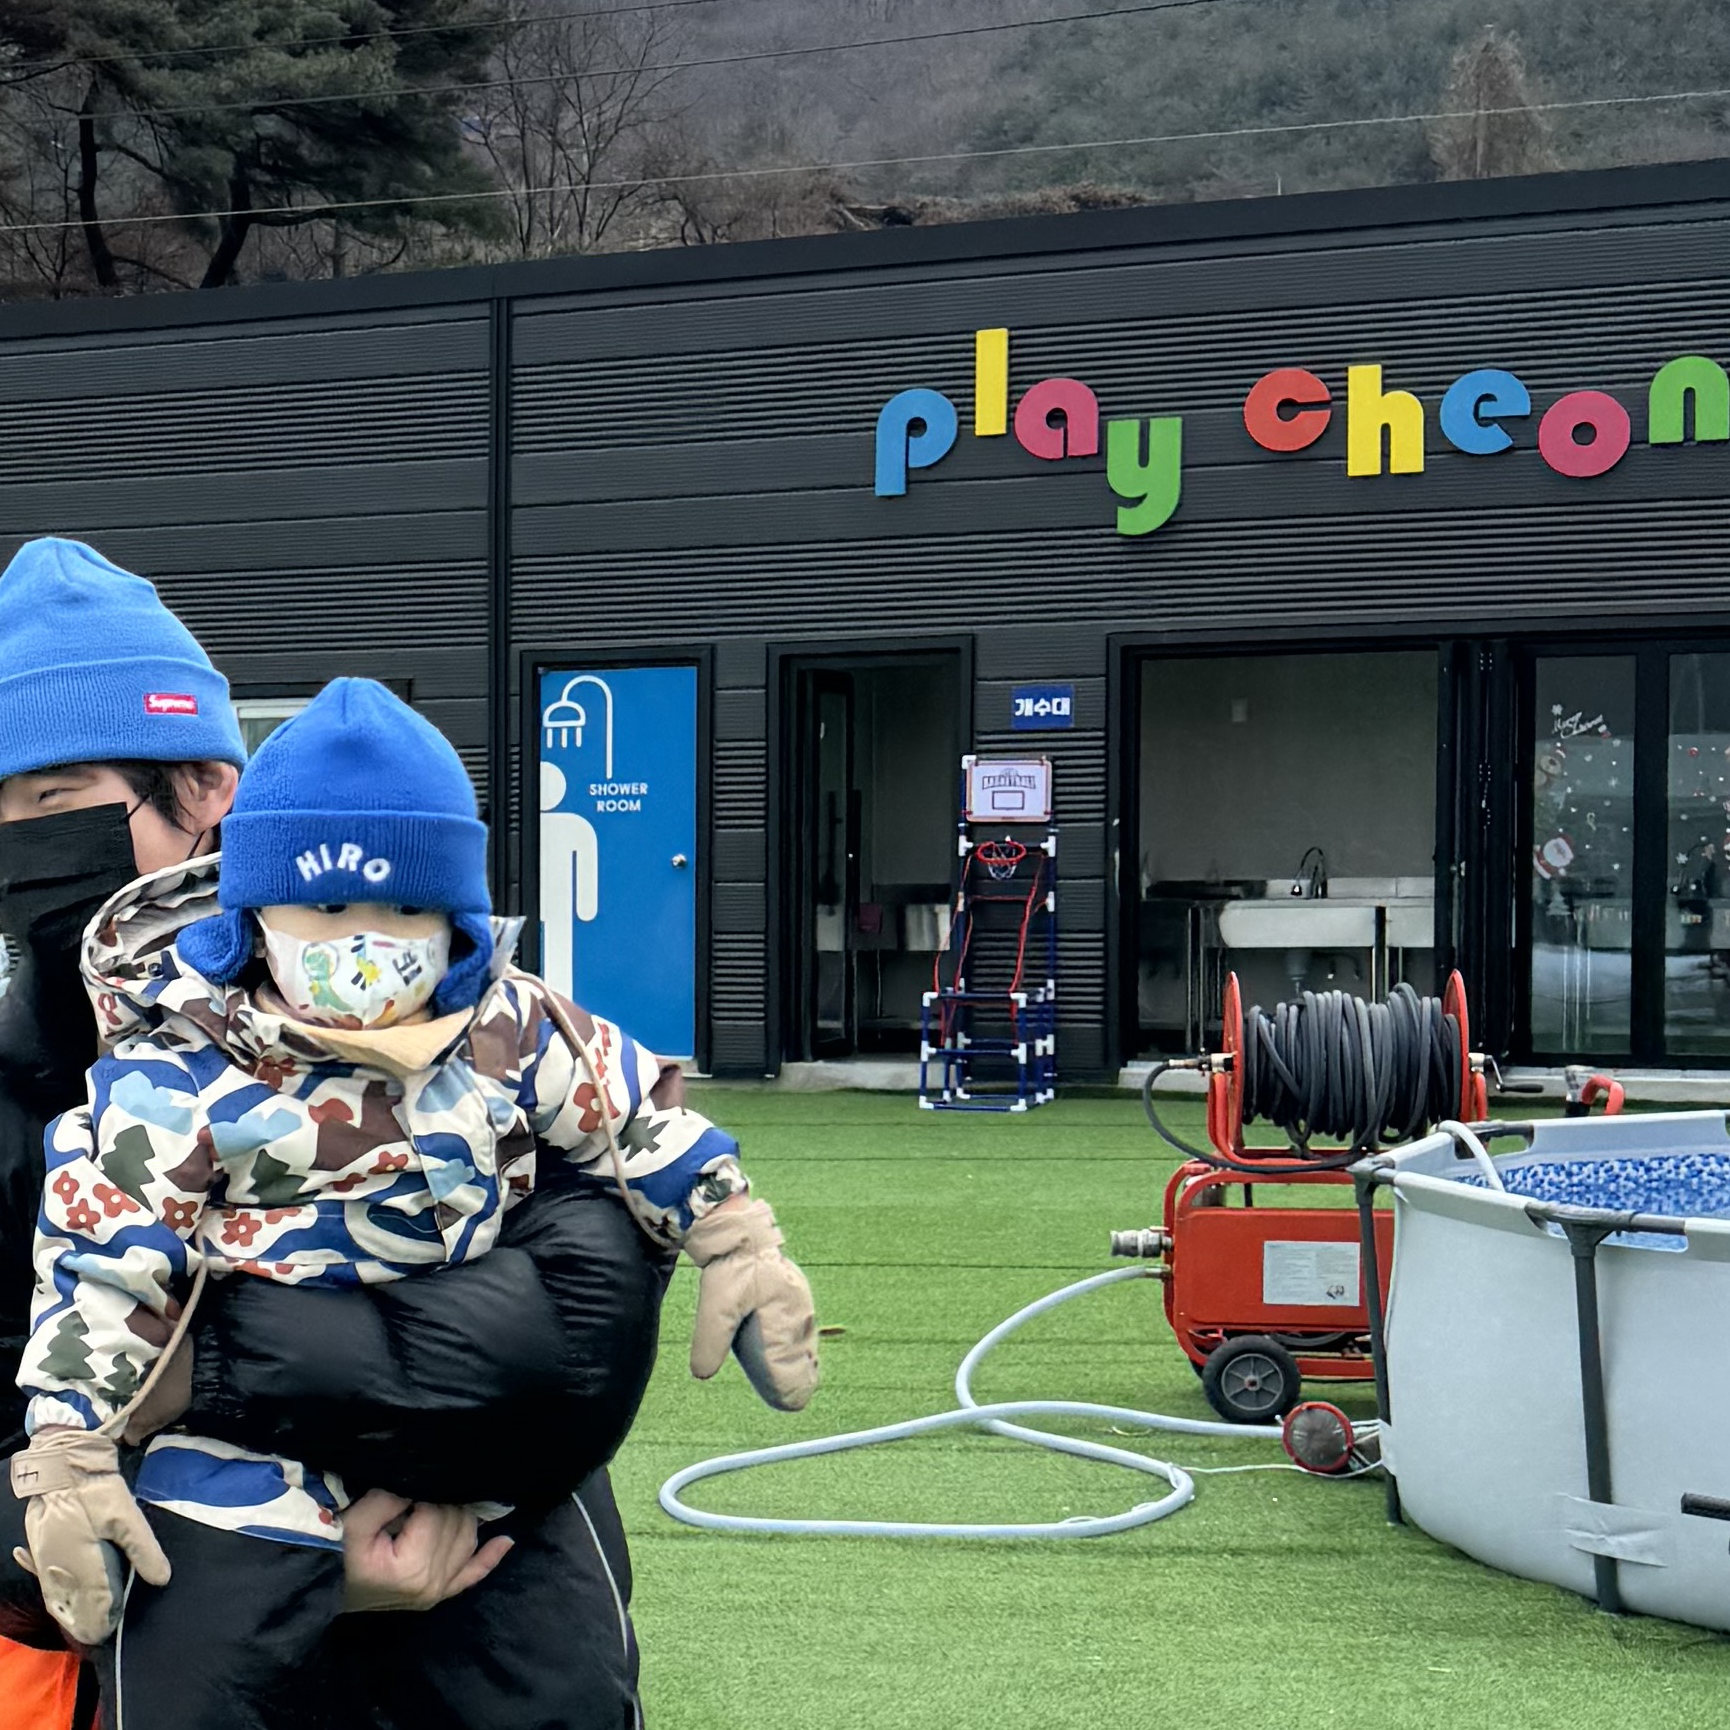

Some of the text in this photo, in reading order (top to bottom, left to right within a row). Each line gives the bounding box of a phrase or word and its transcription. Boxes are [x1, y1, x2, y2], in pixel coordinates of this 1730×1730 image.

[875, 328, 1730, 535] play cheon
[1014, 697, 1071, 717] 개수대
[589, 782, 648, 796] SHOWER
[596, 799, 641, 813] ROOM
[295, 842, 391, 882] HIRO
